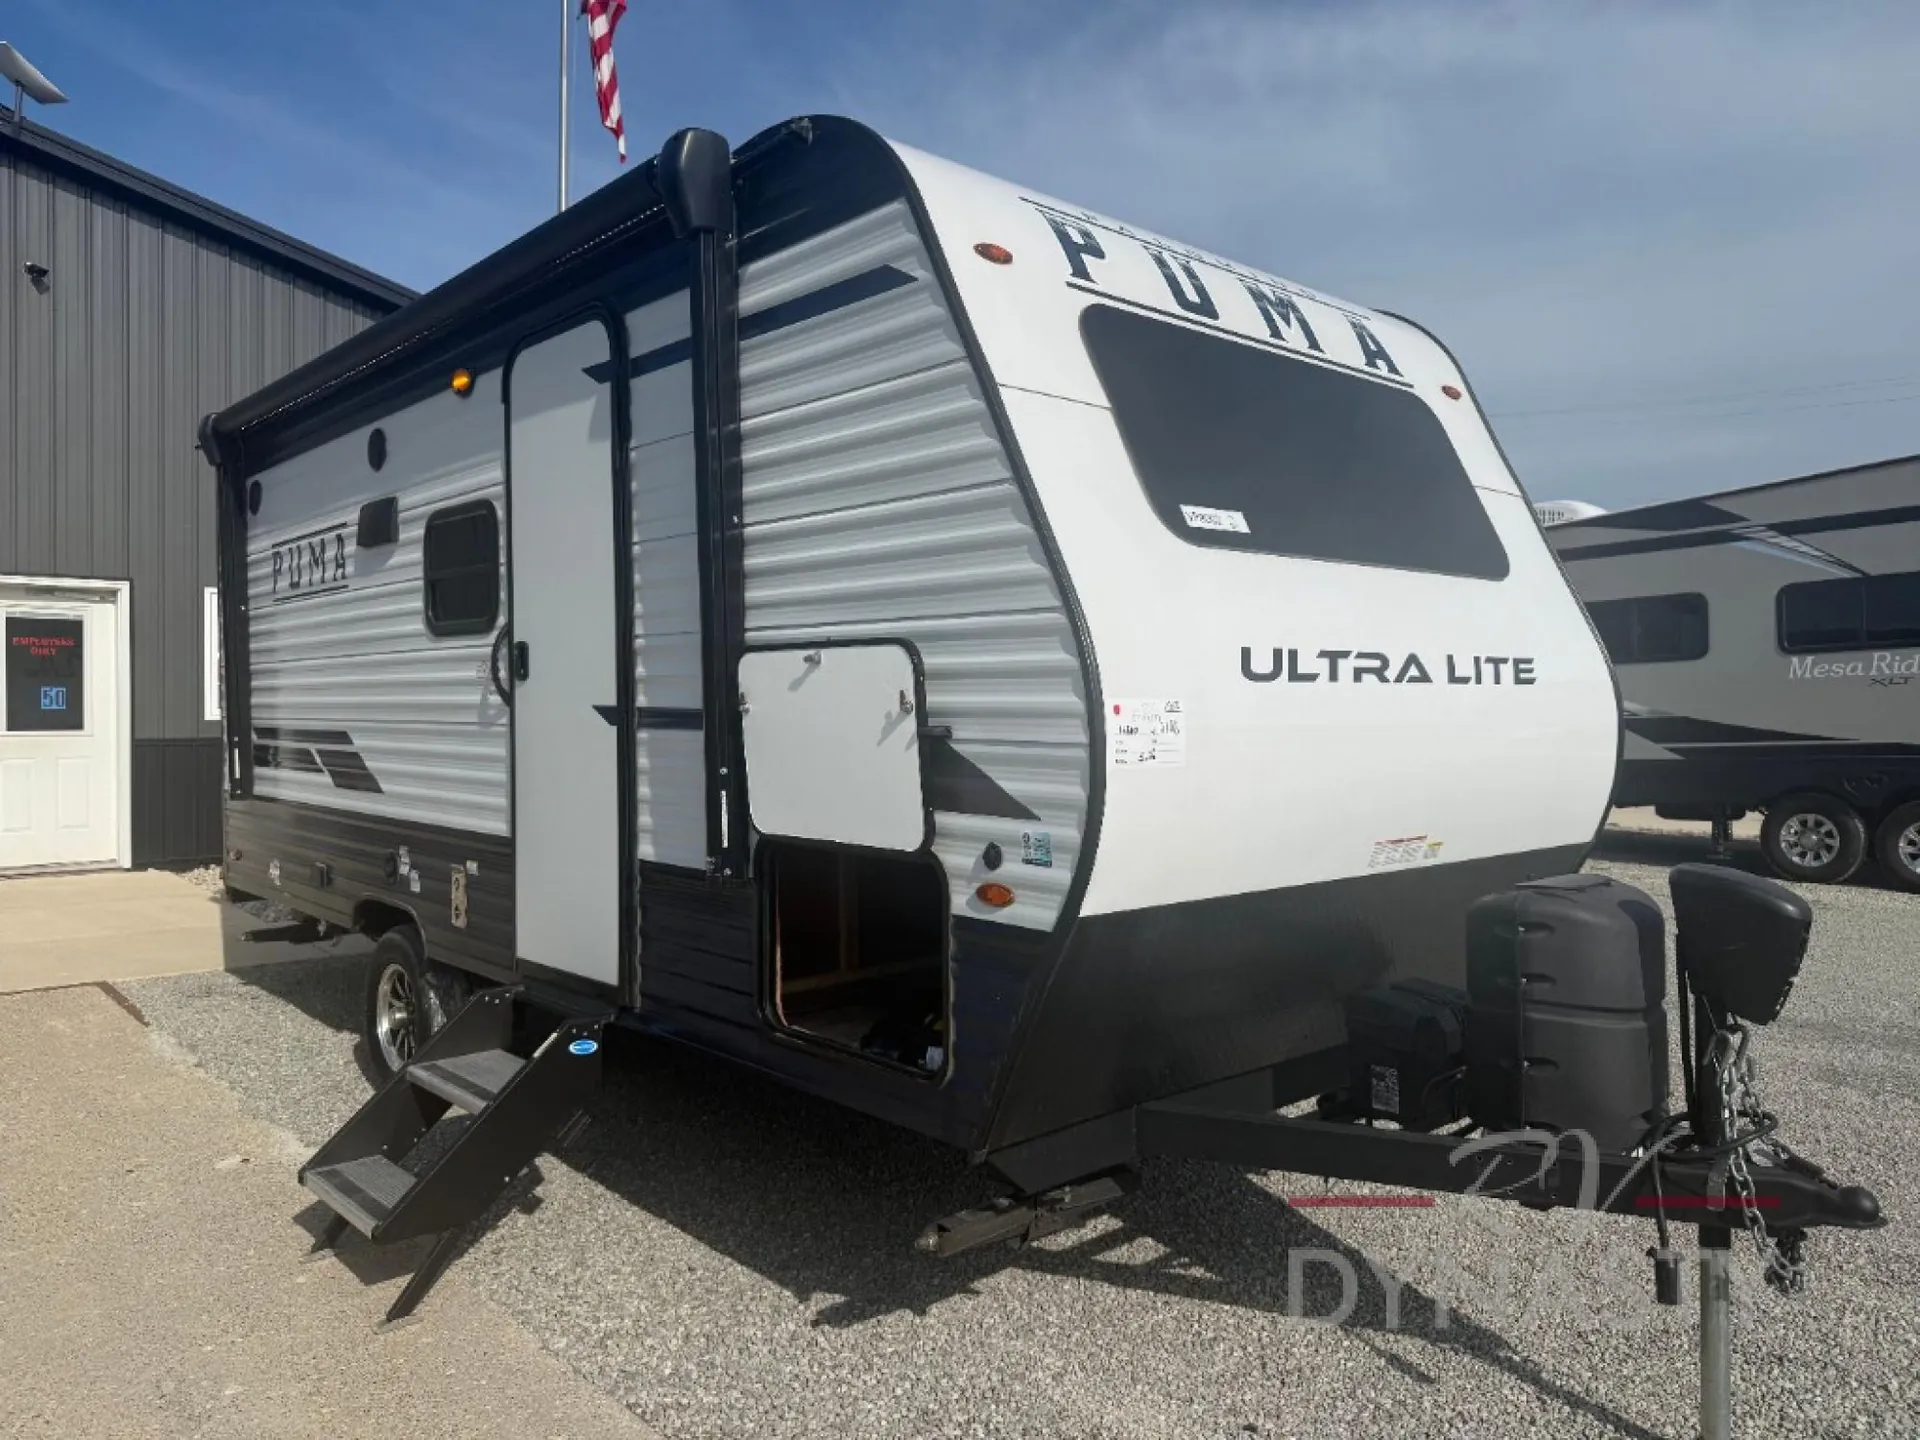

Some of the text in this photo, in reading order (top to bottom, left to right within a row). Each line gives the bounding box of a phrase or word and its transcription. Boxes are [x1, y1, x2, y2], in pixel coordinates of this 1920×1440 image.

[1034, 208, 1405, 378] PUMA
[272, 533, 349, 594] PUMA
[1240, 646, 1538, 685] ULTRA LITE
[1788, 654, 1865, 679] Mesa
